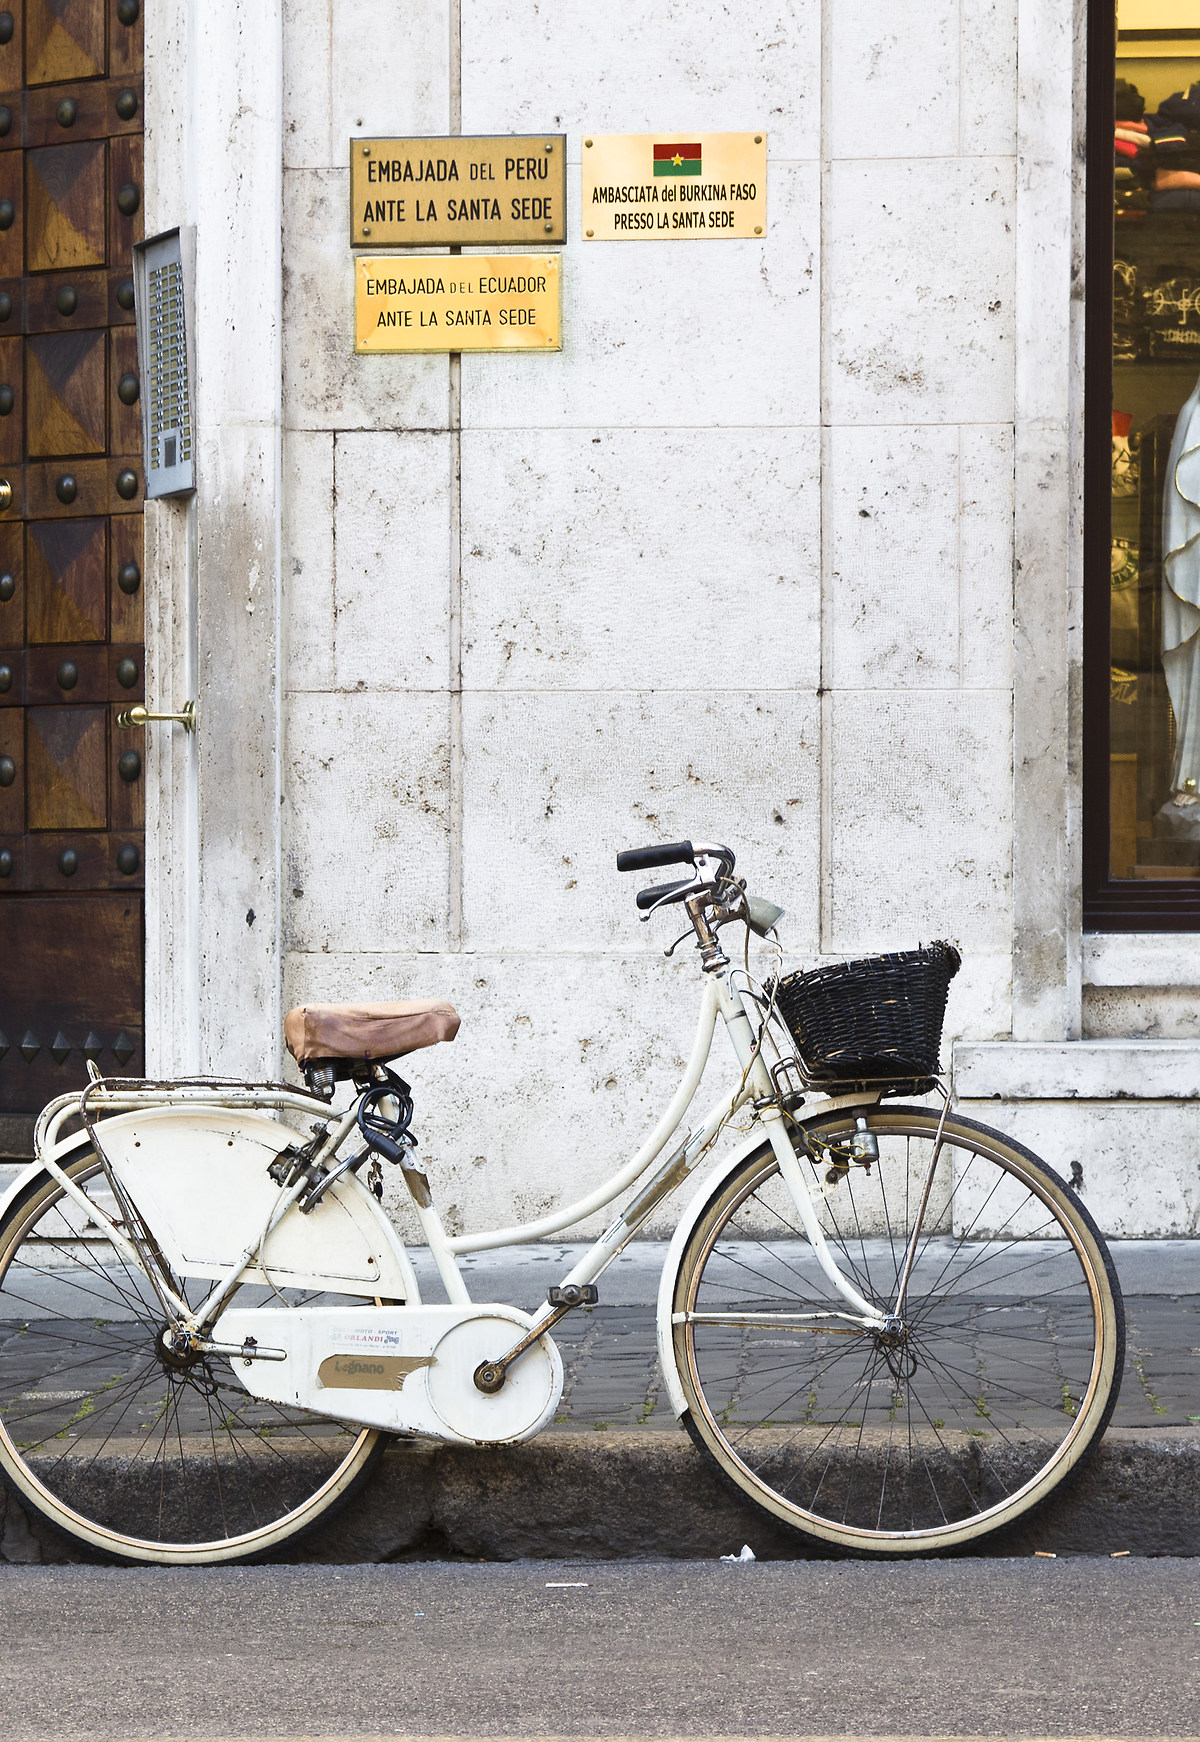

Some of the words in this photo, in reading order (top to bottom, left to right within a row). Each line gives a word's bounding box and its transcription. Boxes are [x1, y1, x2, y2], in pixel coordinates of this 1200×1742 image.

[367, 159, 459, 182] EMBAJADA
[469, 163, 495, 181] DEL
[505, 157, 548, 180] PERU
[592, 185, 659, 204] AMBASCIATA
[661, 184, 677, 202] del
[679, 183, 727, 202] BURKINA
[730, 183, 757, 201] FASO
[363, 200, 406, 222] ANTE
[416, 199, 438, 222] LA
[447, 198, 501, 221] SANTA
[511, 197, 552, 220] SEDE
[614, 212, 654, 230] PRESSO
[657, 212, 670, 229] LA
[672, 211, 706, 229] SANTA
[708, 211, 735, 228] SEDE
[366, 278, 445, 295] EMBAJADA
[450, 282, 474, 294] DEL
[479, 276, 546, 293] ECUADOR
[377, 310, 413, 327] ANTE
[420, 310, 438, 327] LA
[445, 309, 492, 326] SANTA
[499, 308, 536, 325] SEDE
[344, 1334, 384, 1343] ORLANDI
